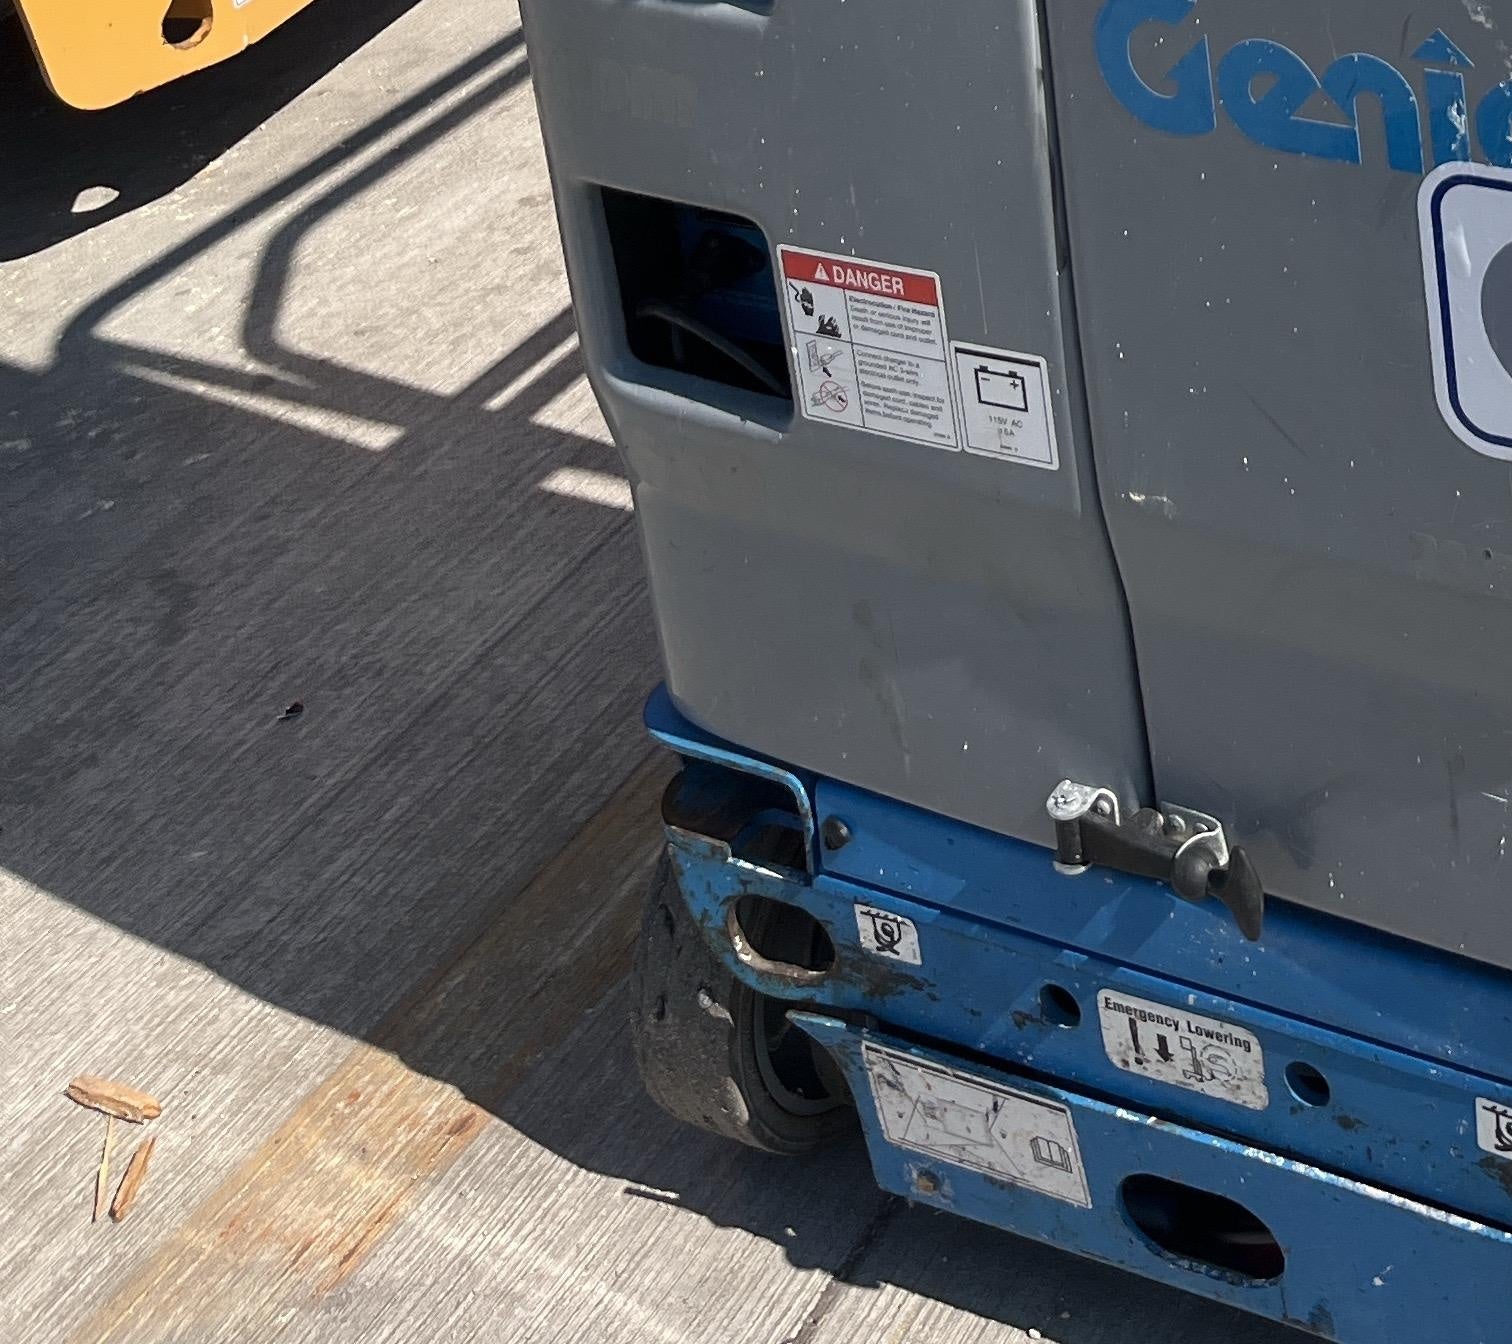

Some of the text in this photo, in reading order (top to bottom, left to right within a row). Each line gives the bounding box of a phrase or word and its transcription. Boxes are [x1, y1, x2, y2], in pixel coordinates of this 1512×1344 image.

[832, 265, 905, 296] DANGER
[1103, 996, 1252, 1053] Emergency Lowering
